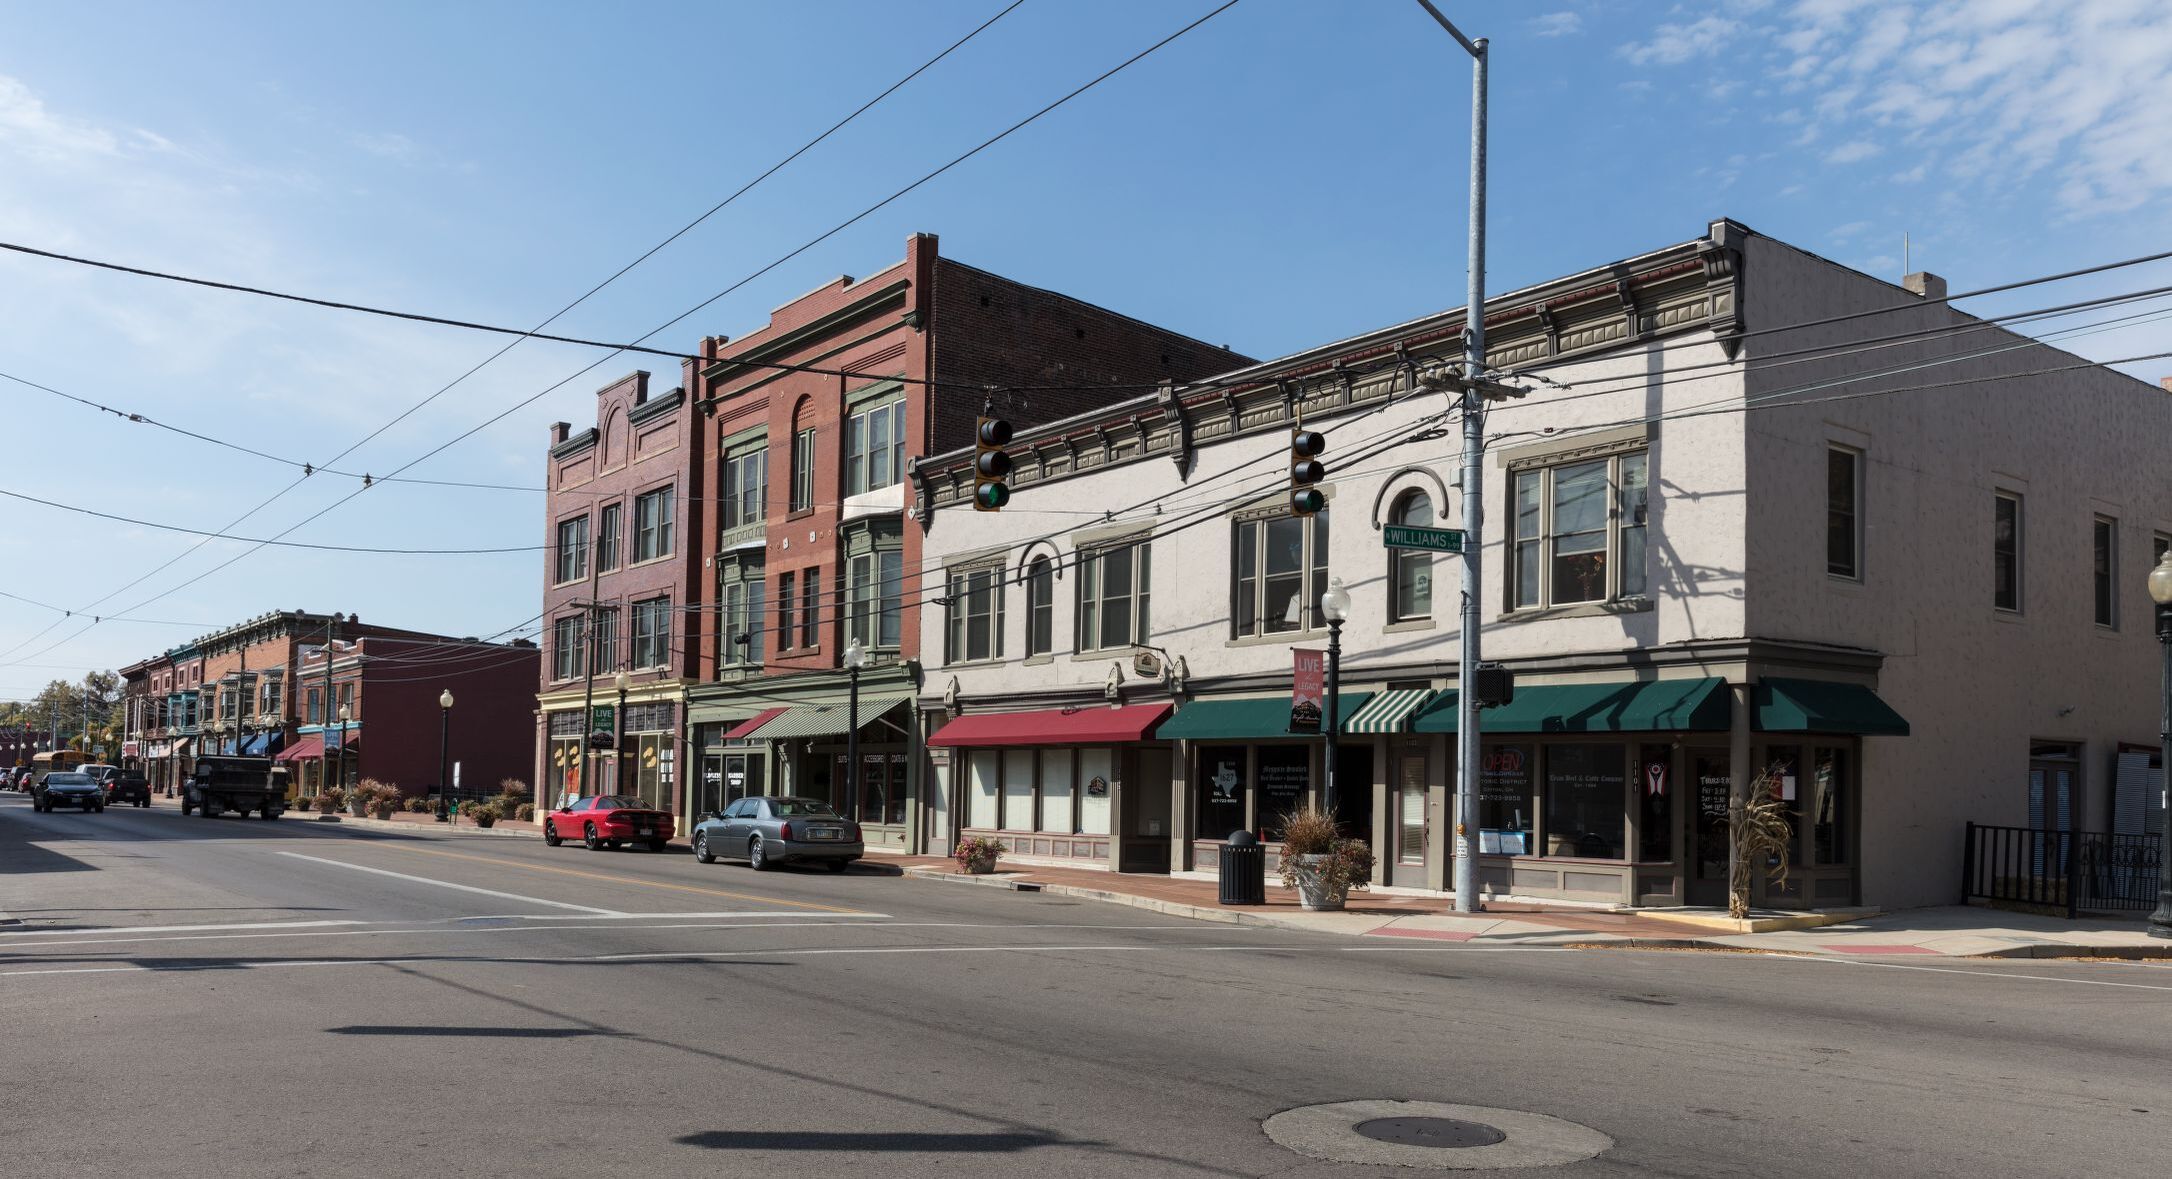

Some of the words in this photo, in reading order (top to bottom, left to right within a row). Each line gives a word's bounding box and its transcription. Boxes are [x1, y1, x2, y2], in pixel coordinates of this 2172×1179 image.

[1391, 530, 1446, 547] WILLIAMS
[1298, 658, 1320, 672] LIVE
[1298, 683, 1320, 691] LEGACY
[595, 709, 612, 718] LIVE
[1484, 752, 1520, 771] OPEN
